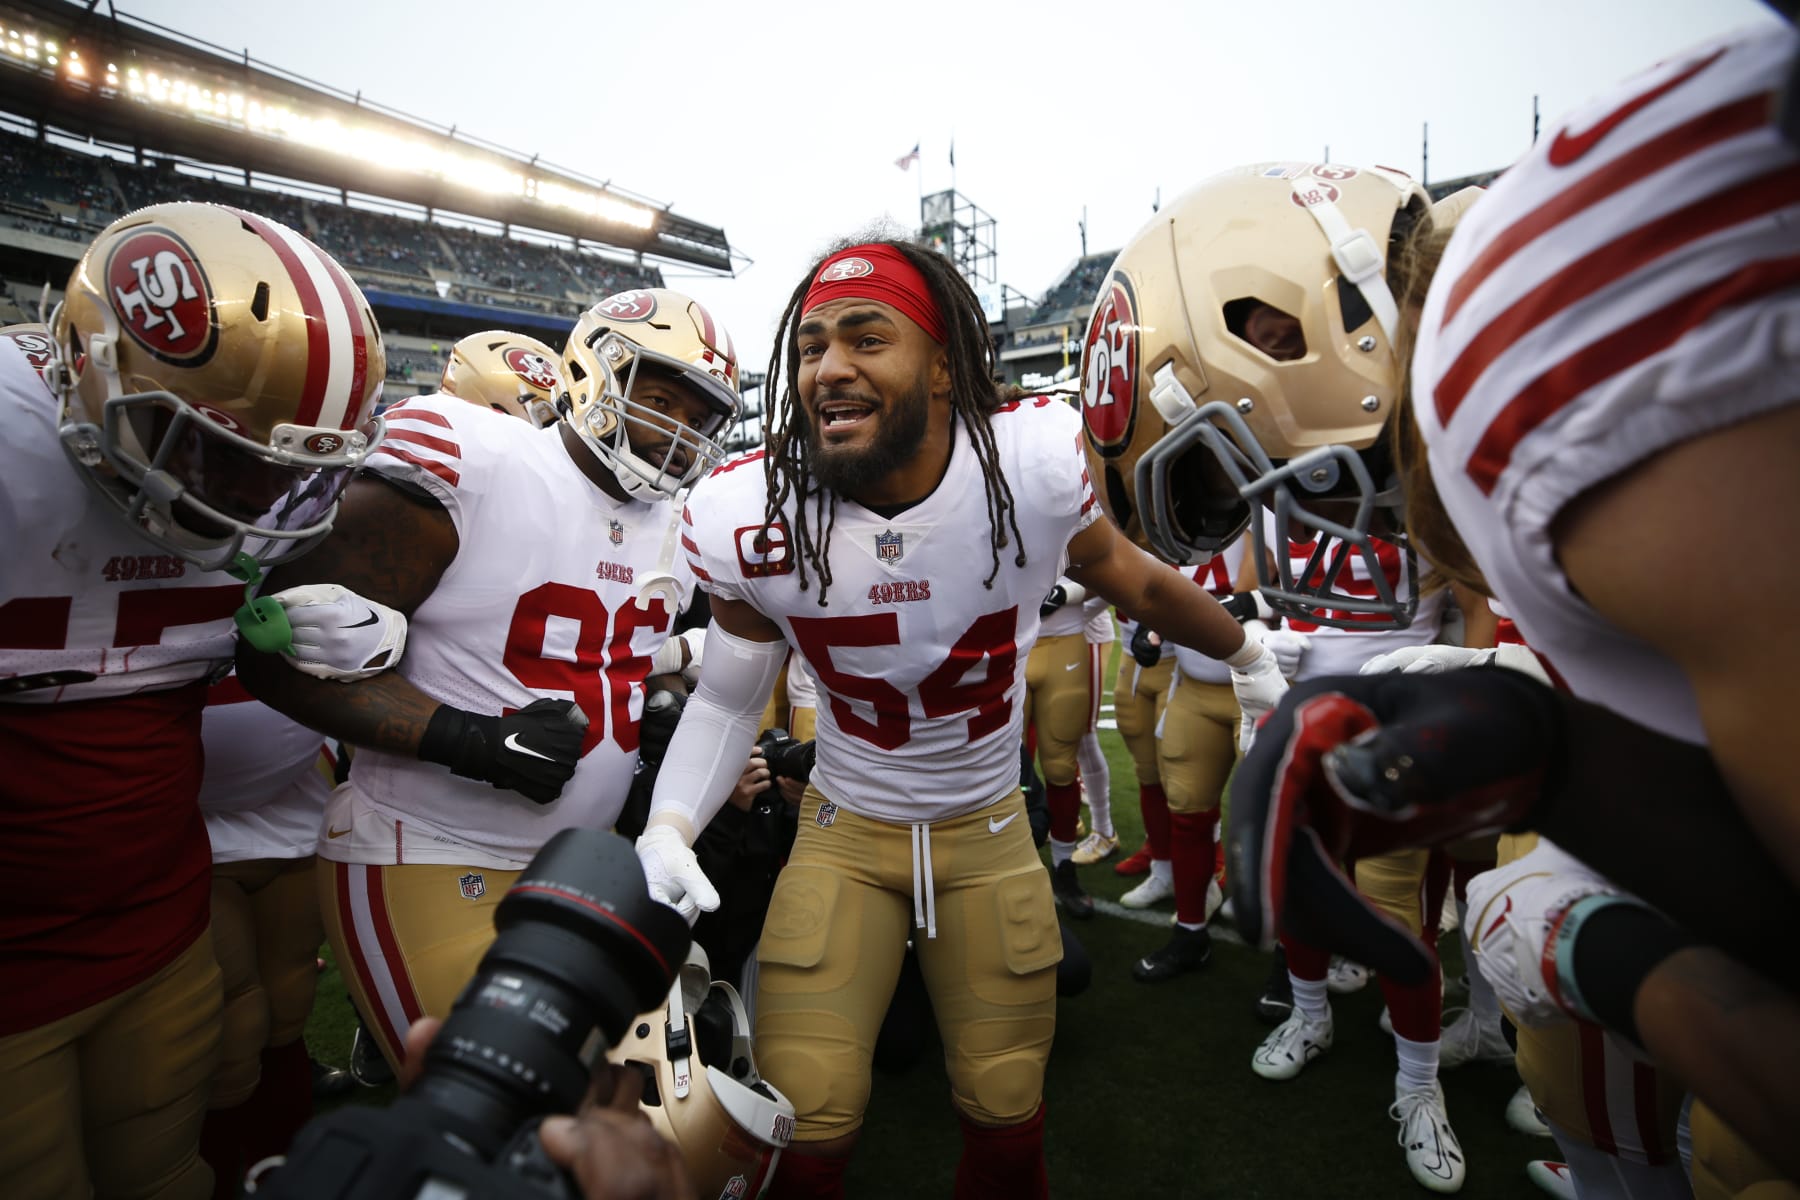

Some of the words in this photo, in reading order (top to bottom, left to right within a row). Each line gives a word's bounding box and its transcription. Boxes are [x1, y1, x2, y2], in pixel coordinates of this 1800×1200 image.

[116, 250, 199, 341] SF
[317, 437, 338, 452] SF
[880, 544, 899, 558] NFL
[102, 555, 187, 582] 49ERS
[596, 560, 634, 585] 49ERS
[868, 579, 931, 605] 49ERS
[502, 581, 671, 758] 96
[786, 603, 1019, 751] 54
[464, 883, 482, 896] NFL
